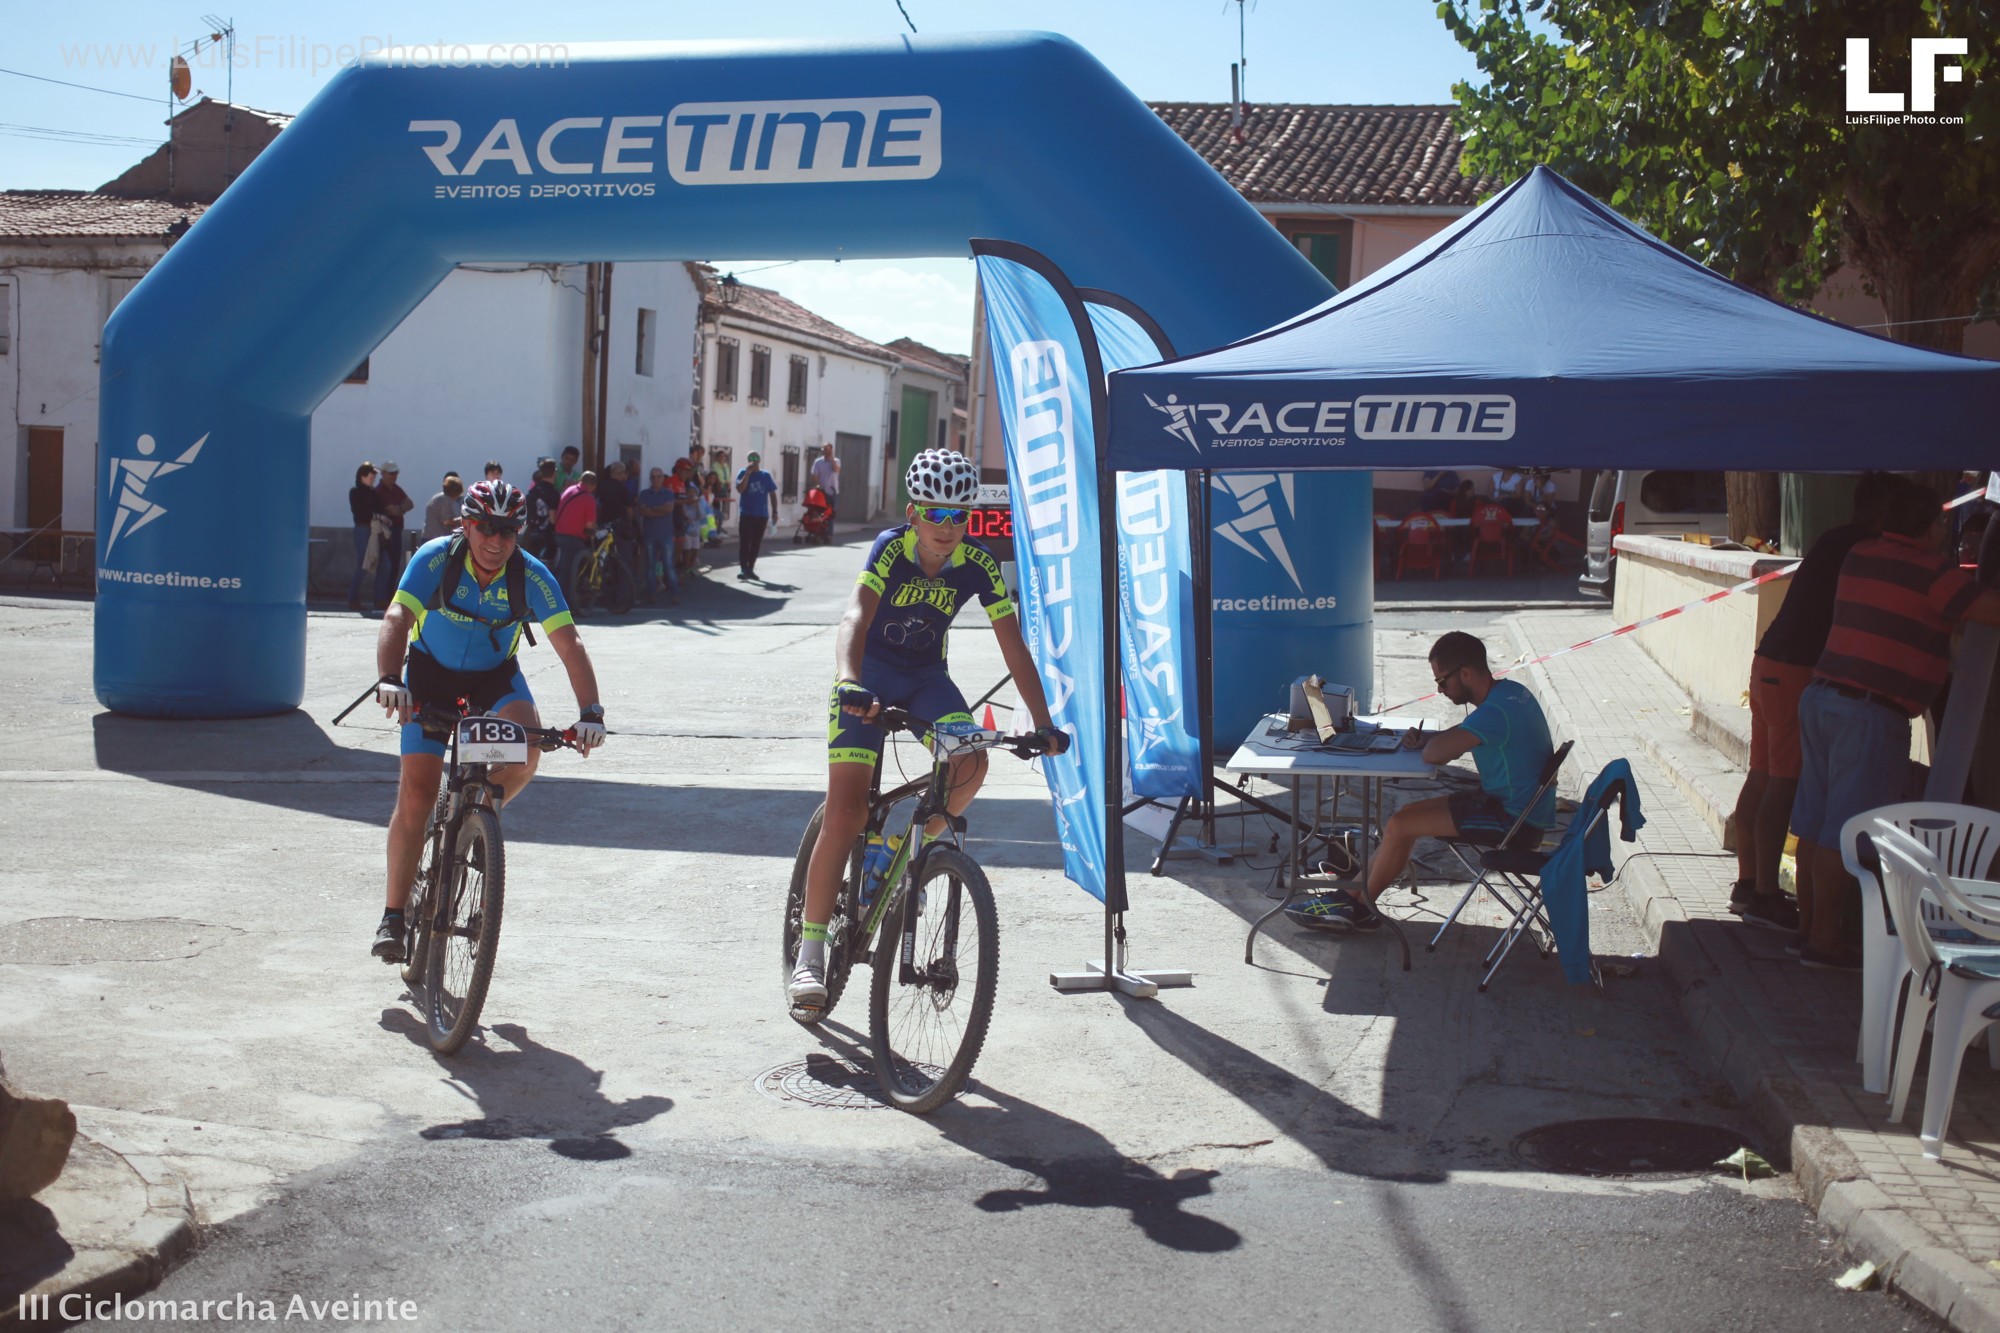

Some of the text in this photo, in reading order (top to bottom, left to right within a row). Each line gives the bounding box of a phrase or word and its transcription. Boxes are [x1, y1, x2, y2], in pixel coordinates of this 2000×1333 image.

[434, 183, 656, 198] EVENTOS DEPORTIVOS
[1211, 437, 1345, 447] EVENTOS DEPORTIVOS
[964, 546, 1001, 584] UBEDA
[98, 567, 241, 589] www.racetime.es
[891, 583, 957, 616] UBEDA
[470, 722, 516, 741] 133
